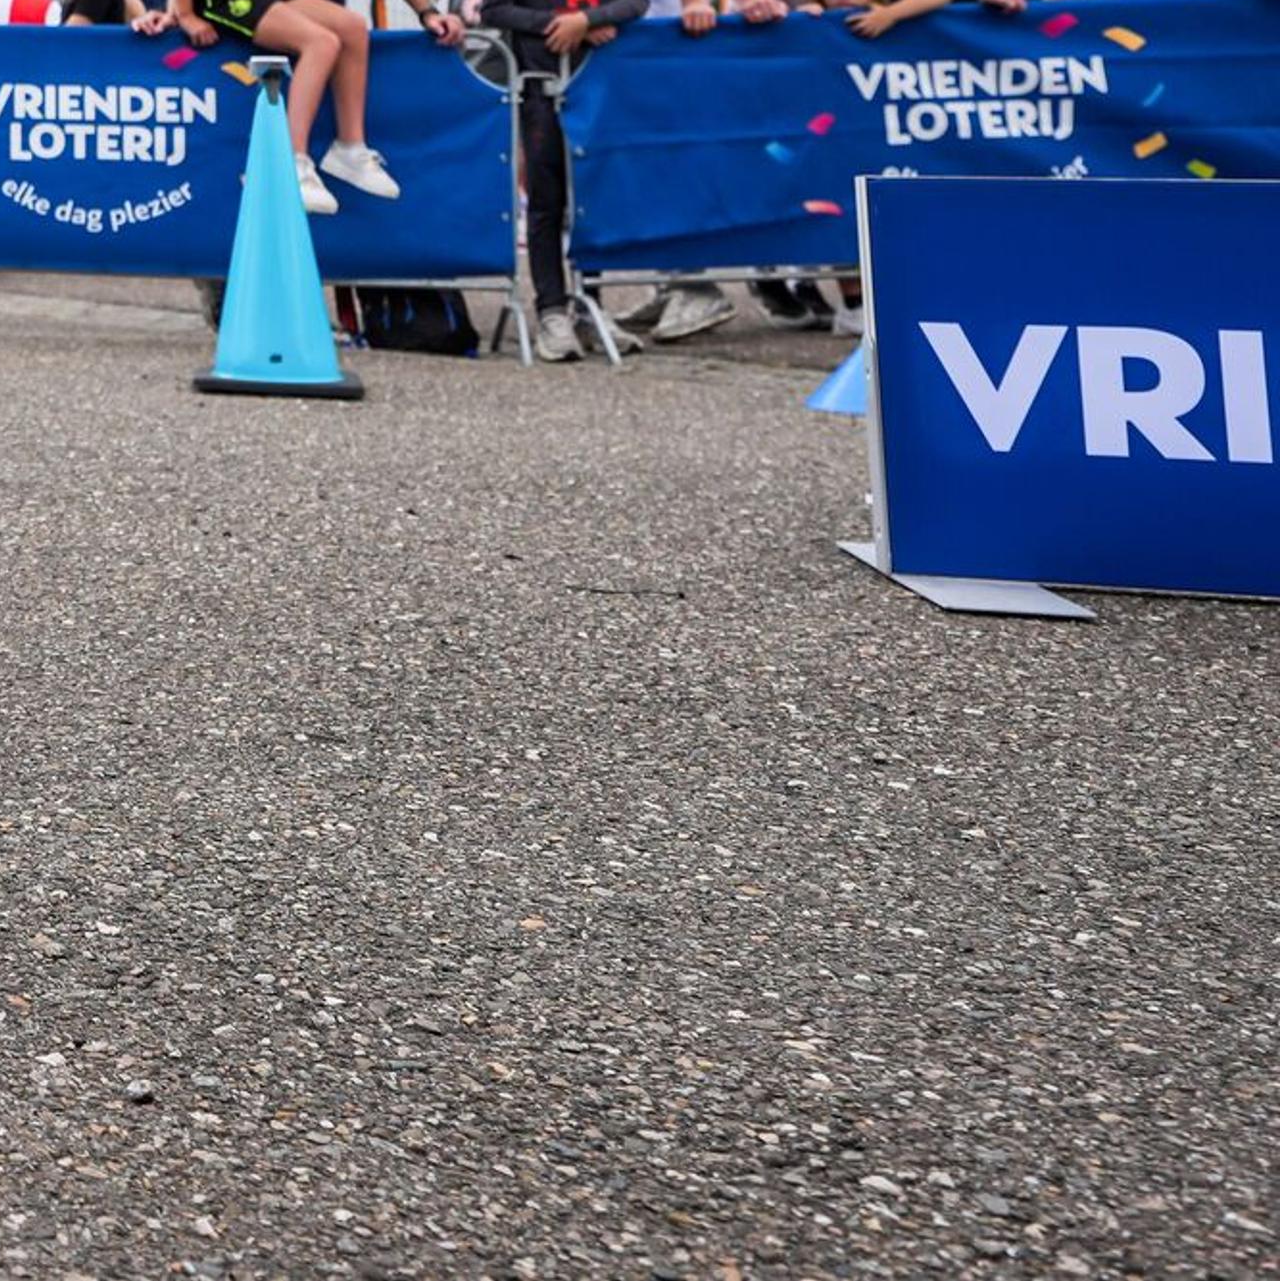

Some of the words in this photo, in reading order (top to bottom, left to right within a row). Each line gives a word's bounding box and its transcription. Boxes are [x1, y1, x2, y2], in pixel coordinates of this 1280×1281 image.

[847, 55, 1109, 101] VRIENDEN
[10, 122, 186, 166] LOTERIJ
[883, 98, 1074, 146] LOTERIJ
[1, 179, 51, 215] elke
[54, 200, 103, 233] dag
[110, 181, 192, 232] plezier
[918, 321, 1273, 463] VRI
